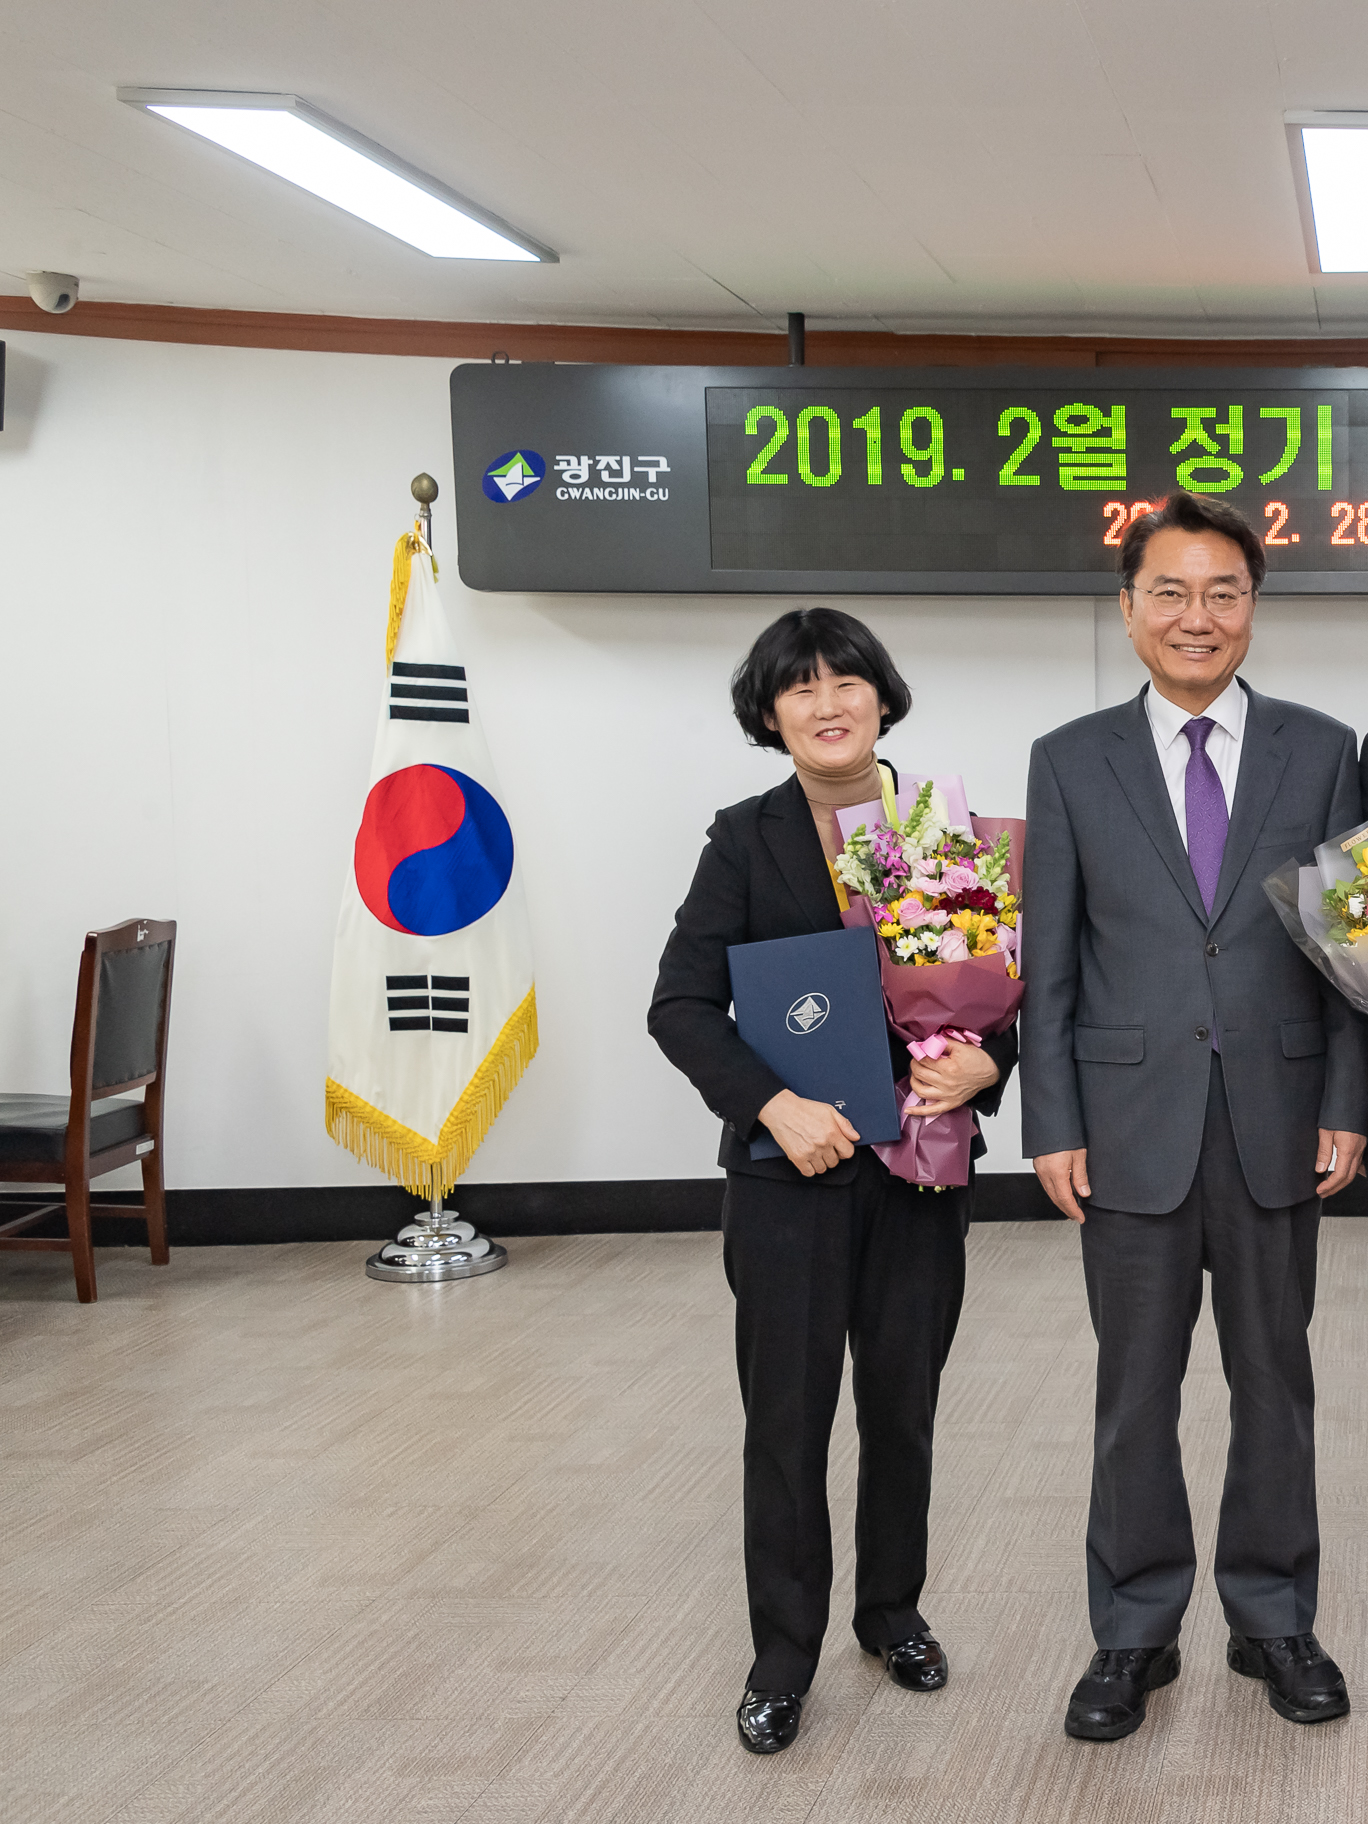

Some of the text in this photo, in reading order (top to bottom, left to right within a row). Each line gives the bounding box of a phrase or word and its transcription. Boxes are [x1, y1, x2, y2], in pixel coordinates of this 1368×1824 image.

[744, 406, 964, 488] 2019.
[998, 402, 1127, 491] 2월
[1169, 404, 1333, 493] 정기
[554, 455, 671, 484] 광진구
[556, 486, 669, 501] GWANGJIN-GU
[1264, 501, 1300, 545] 2.
